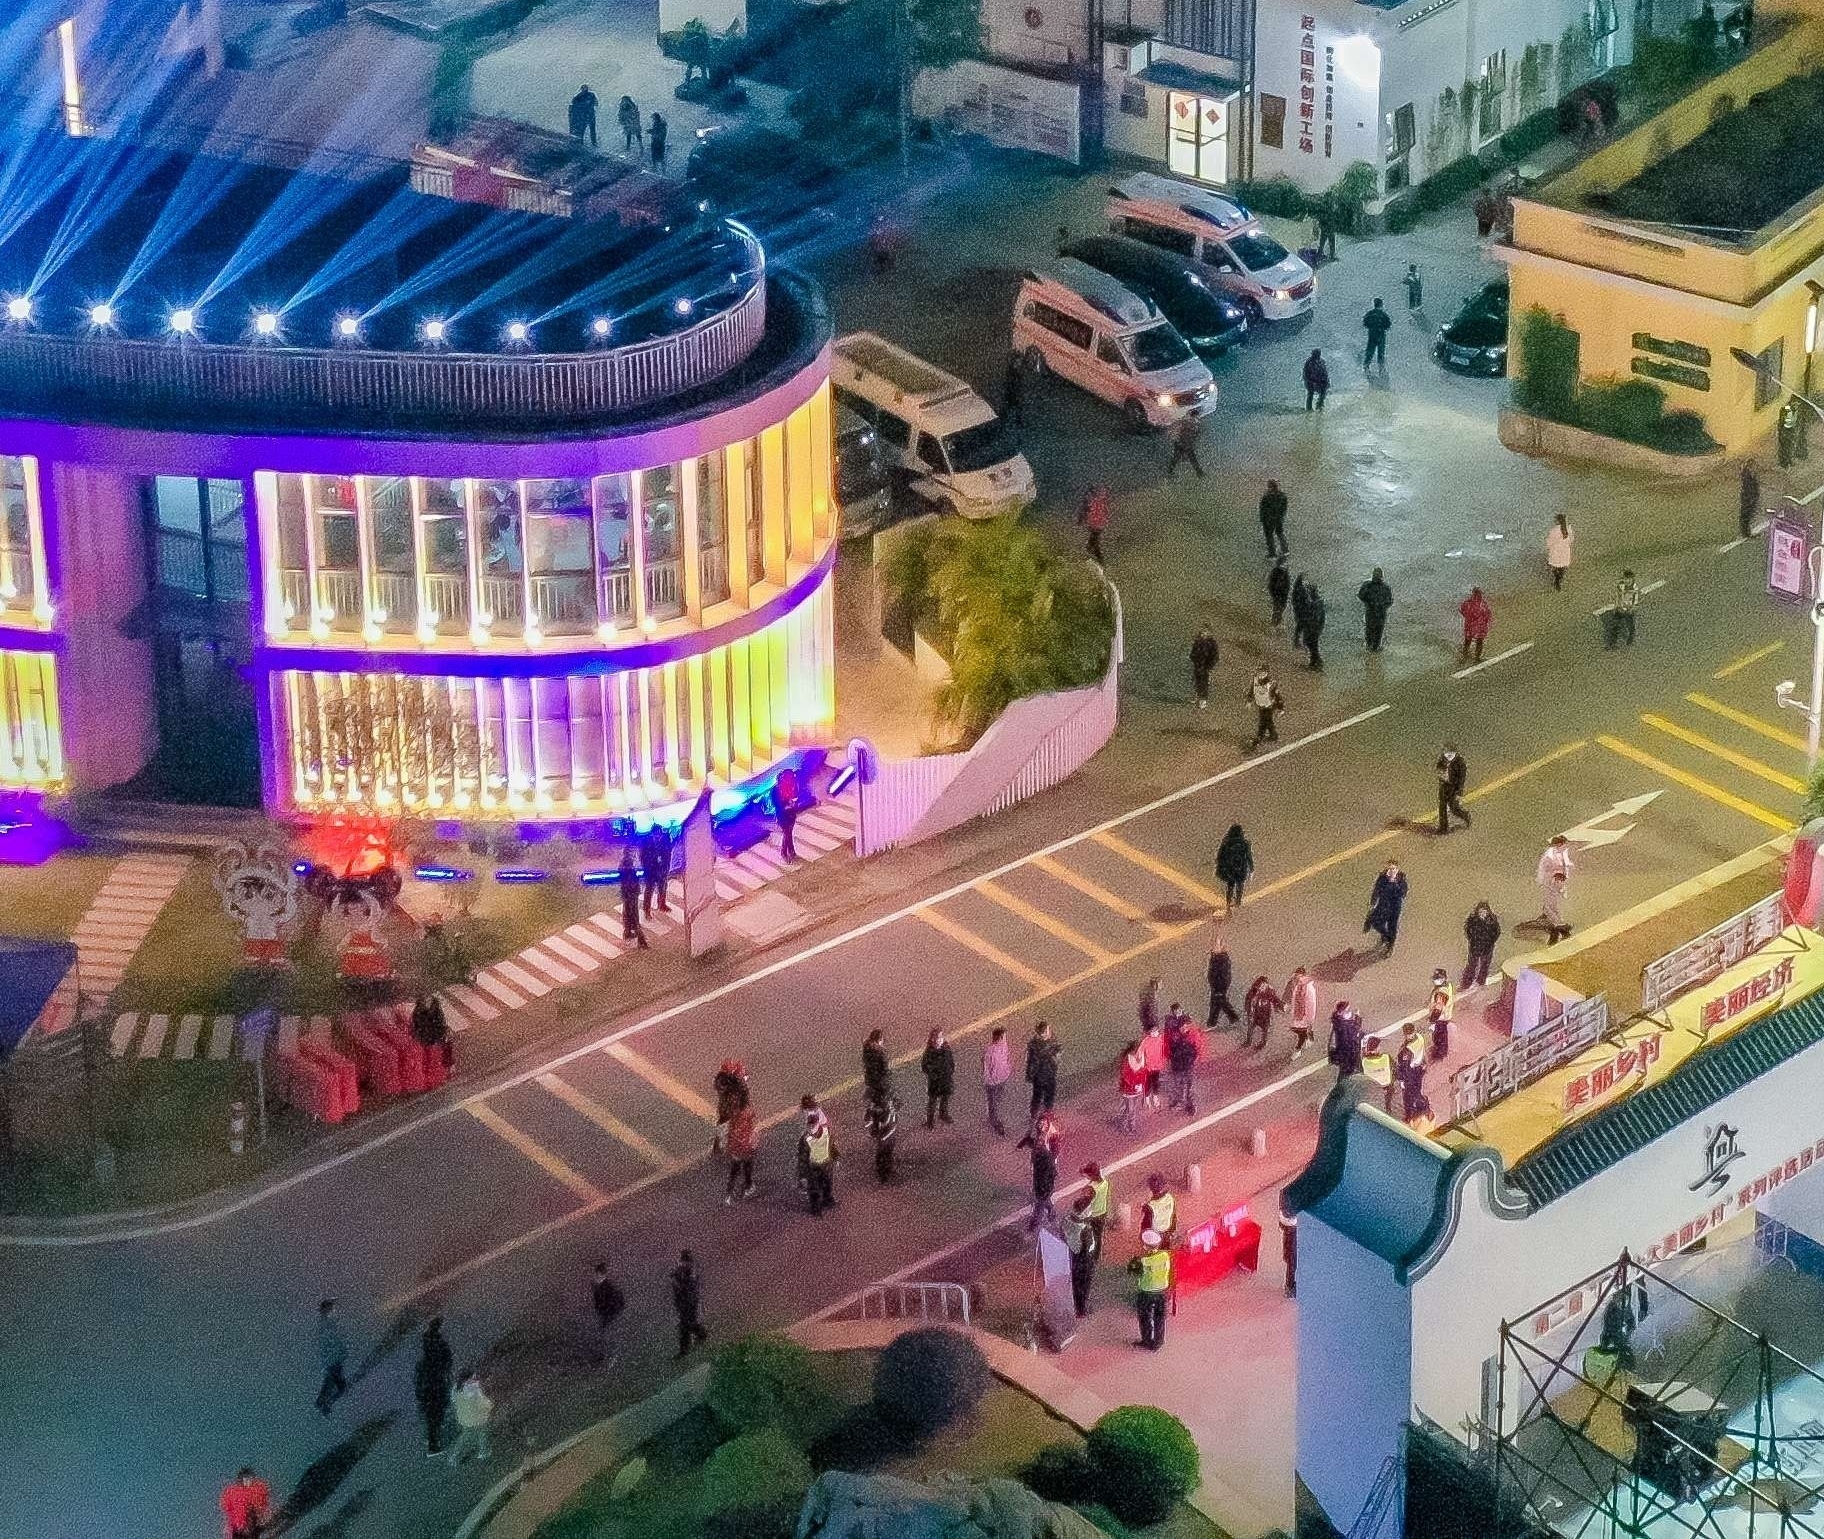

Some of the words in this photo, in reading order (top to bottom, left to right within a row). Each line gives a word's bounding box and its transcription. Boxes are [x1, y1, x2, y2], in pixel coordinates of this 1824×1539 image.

[1299, 13, 1316, 154] 起点国际创新工场
[1564, 1032, 1662, 1110] 美丽乡村
